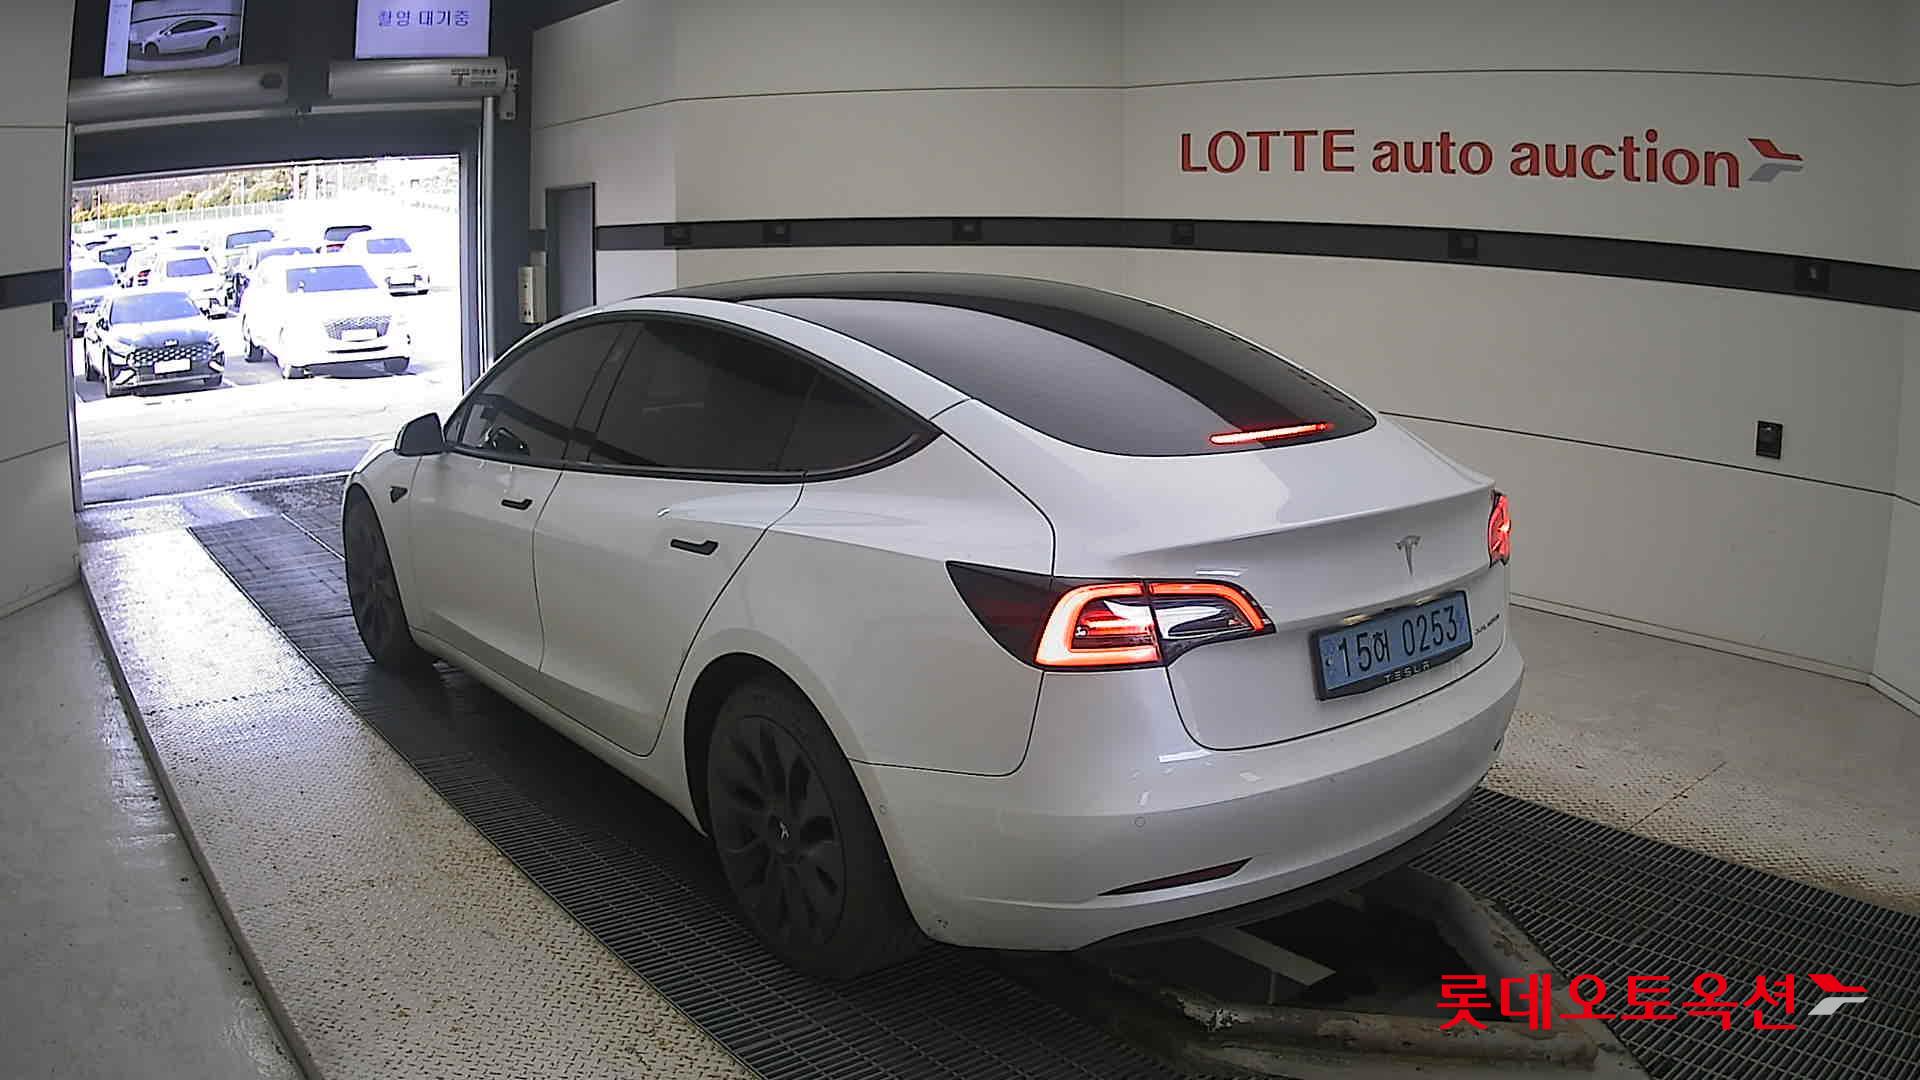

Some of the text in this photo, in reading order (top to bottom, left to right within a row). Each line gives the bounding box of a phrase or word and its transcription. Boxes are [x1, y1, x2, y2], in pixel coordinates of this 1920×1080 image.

[419, 9, 469, 27] 대기중
[1180, 129, 1740, 188] LOTTE auto auction
[1401, 605, 1457, 657] 0253
[1383, 661, 1431, 682] TESLA
